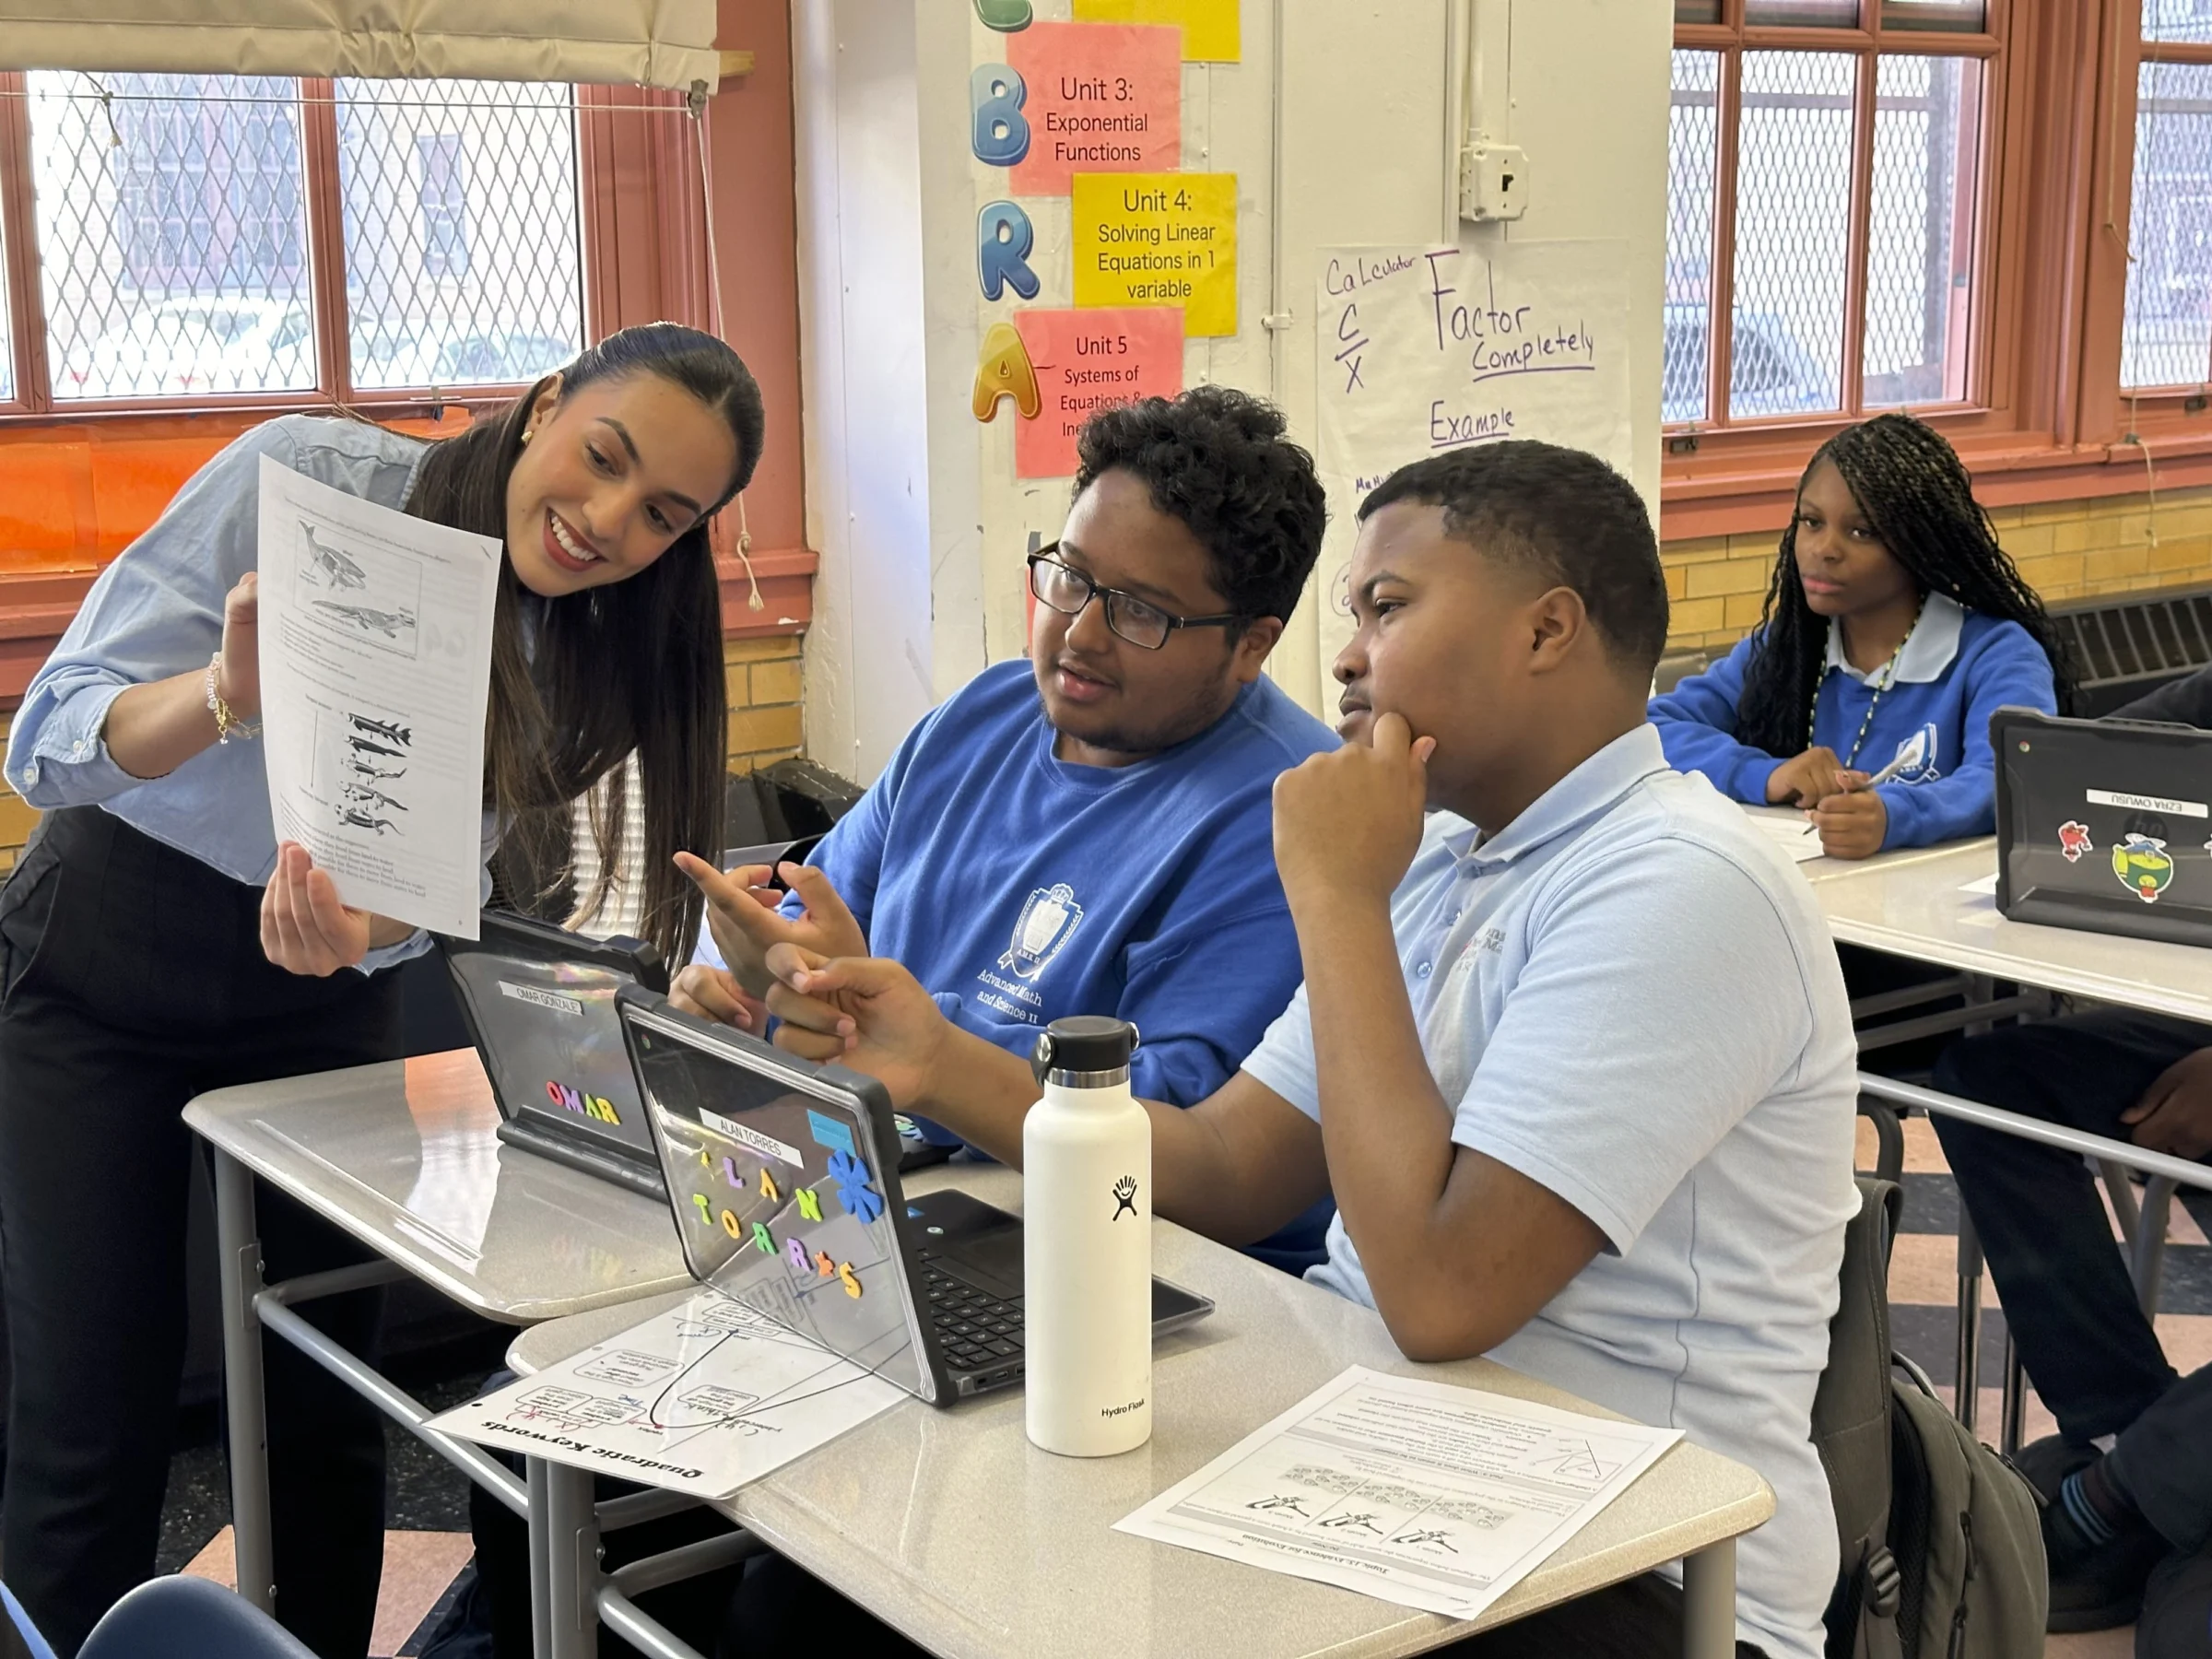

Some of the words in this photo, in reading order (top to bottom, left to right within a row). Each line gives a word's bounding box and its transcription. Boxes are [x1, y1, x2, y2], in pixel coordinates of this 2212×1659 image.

[1060, 77, 1107, 101] Unit
[1114, 77, 1134, 101] 3:
[1046, 112, 1148, 135] Exponential
[1054, 142, 1142, 162] Functions
[1124, 188, 1168, 212] Unit
[1173, 190, 1193, 212] 4:
[1098, 225, 1161, 245] Solving
[1166, 223, 1216, 241] Linear
[1098, 252, 1182, 275] Equations
[1187, 251, 1202, 269] in
[1208, 250, 1216, 268] 1
[1126, 280, 1193, 299] variable
[1425, 249, 1531, 351] Factor
[1076, 336, 1112, 356] Unit
[1117, 335, 1128, 355] 5
[1472, 319, 1594, 371] Completely
[1065, 367, 1122, 387] Systems
[1125, 365, 1140, 382] of
[1430, 400, 1515, 441] Example
[2112, 794, 2152, 808] OWUSU
[2154, 800, 2183, 812] EZRA
[517, 988, 541, 1003] OMAR
[977, 969, 1020, 995] Advanced
[1016, 985, 1041, 1006] Math
[977, 991, 996, 1006] and
[993, 995, 1027, 1020] Science
[1029, 1012, 1039, 1024] II
[546, 1080, 622, 1125] OMAR
[721, 1119, 744, 1139] ALAN
[744, 1129, 782, 1156] TORRES
[1101, 1406, 1127, 1419] Hydro
[480, 1421, 593, 1453] Keywords
[592, 1447, 705, 1478] Quadratic
[1242, 1535, 1288, 1550] Evolution
[1362, 1561, 1390, 1575] Topic
